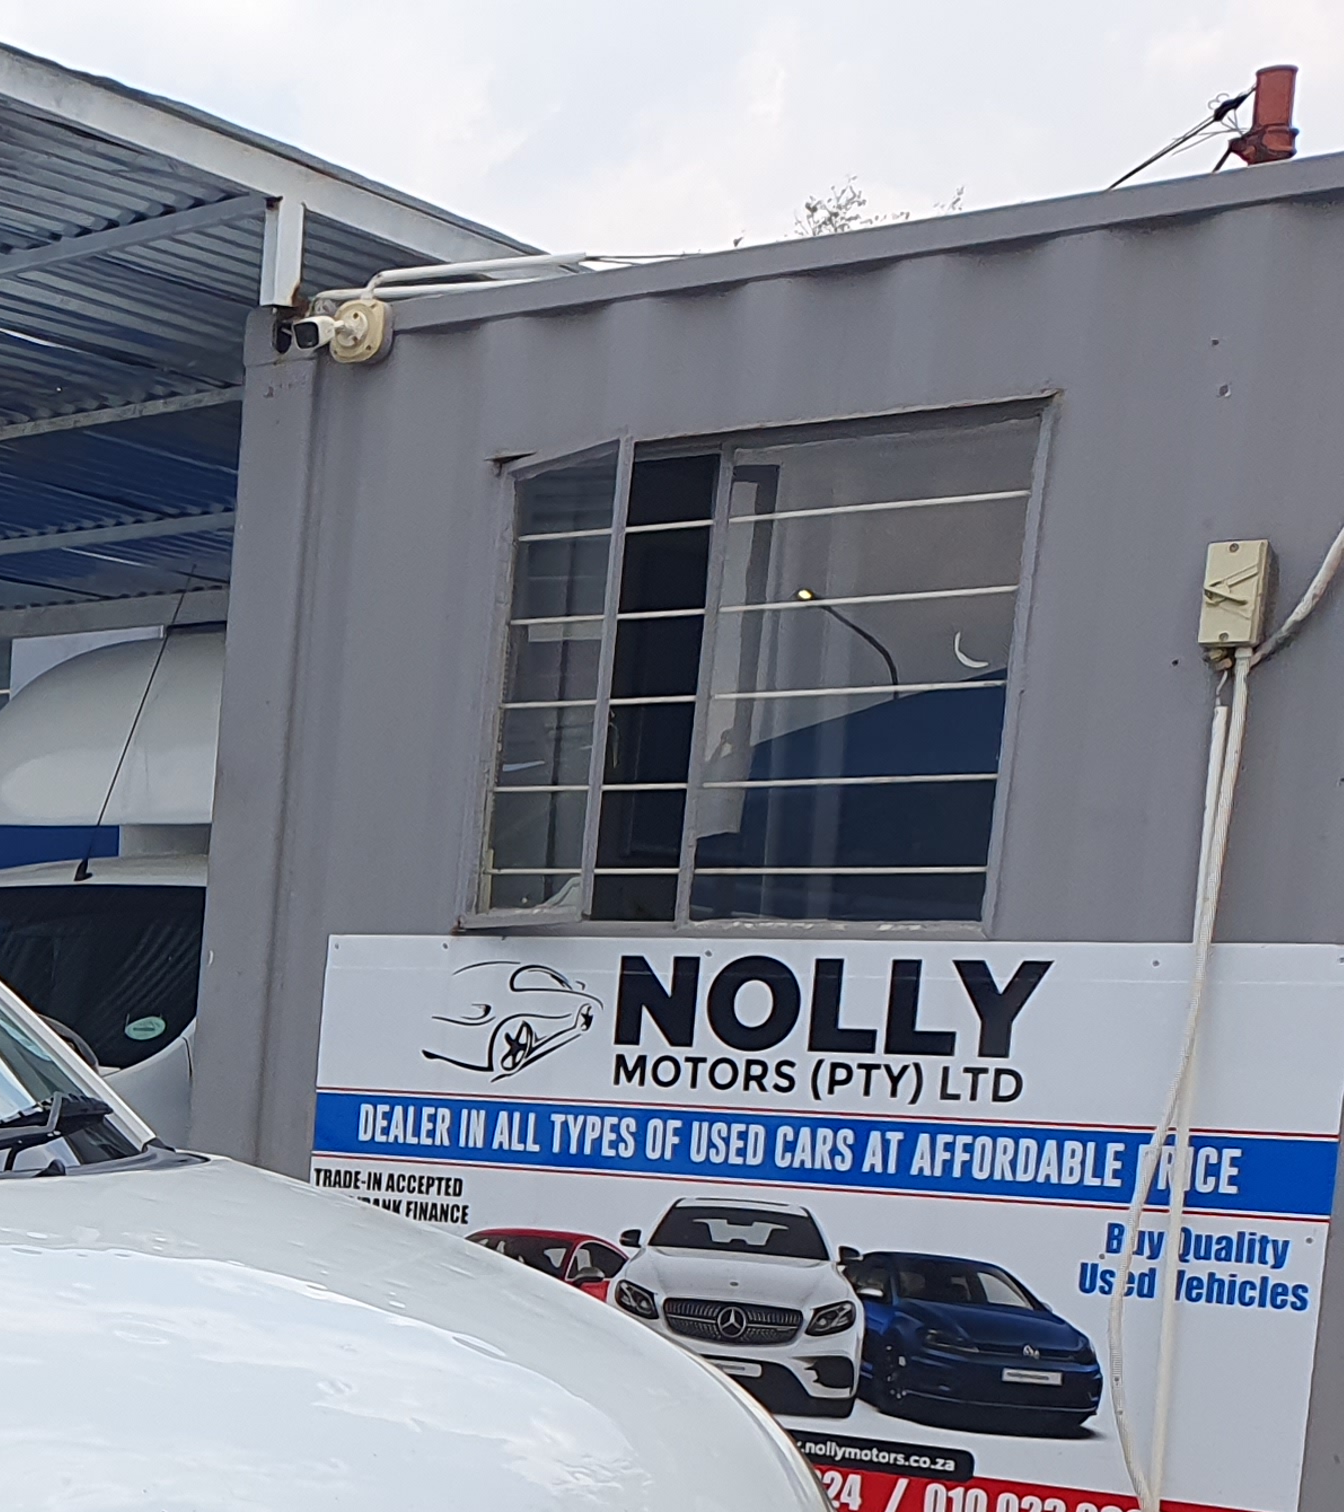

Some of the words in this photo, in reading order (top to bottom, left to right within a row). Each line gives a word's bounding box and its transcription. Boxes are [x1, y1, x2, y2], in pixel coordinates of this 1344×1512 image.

[613, 955, 1055, 1058] NOLLY
[613, 1054, 796, 1094] MOTORS
[811, 1058, 923, 1105] (PTY)
[939, 1066, 1024, 1103] LTD
[358, 1103, 451, 1147] DEALER
[458, 1108, 486, 1149] IN
[492, 1110, 541, 1152] ALL
[550, 1113, 637, 1158] TYPES
[645, 1118, 682, 1161] OF
[689, 1121, 765, 1166] USED
[775, 1126, 853, 1172] CARS
[861, 1131, 904, 1175] AT
[910, 1133, 1125, 1187] AFFORDABLE
[314, 1168, 382, 1192] TRADE-IN
[385, 1173, 463, 1197] ACCEPTED
[405, 1201, 470, 1225] FINANCE
